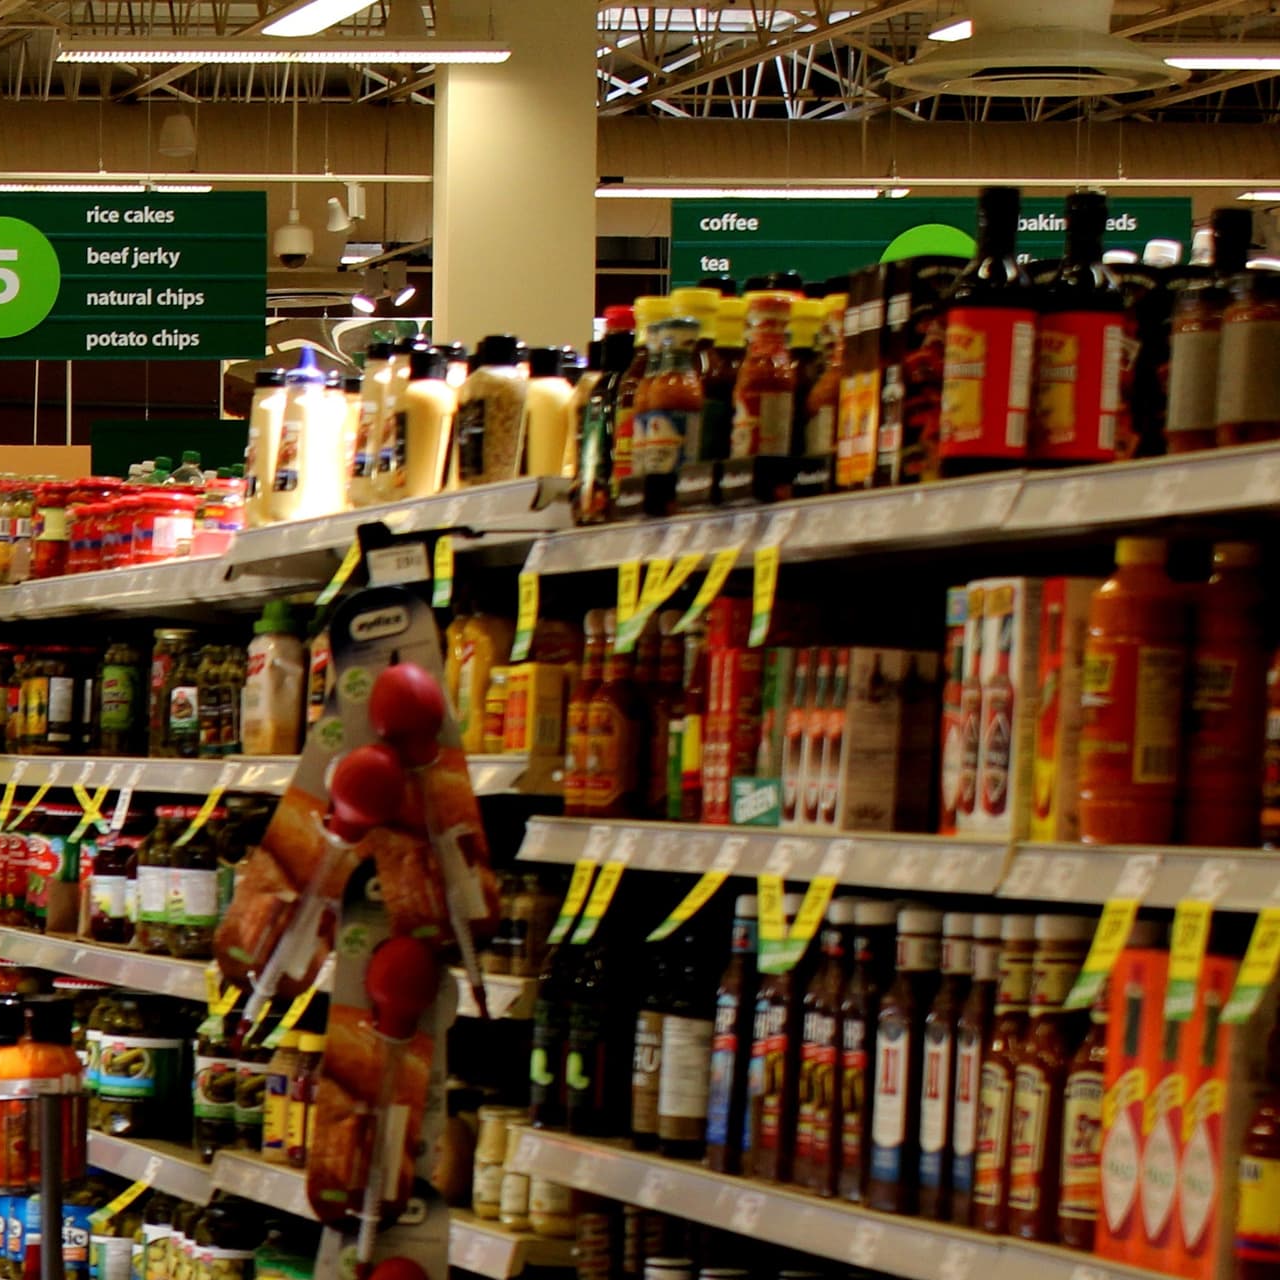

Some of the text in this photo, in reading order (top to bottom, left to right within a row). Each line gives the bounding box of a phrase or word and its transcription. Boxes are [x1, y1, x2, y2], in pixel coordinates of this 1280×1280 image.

[87, 206, 174, 223] rice cakes
[700, 213, 759, 230] coffee
[1017, 213, 1137, 231] bakin eds
[87, 246, 181, 268] beef jerky
[700, 256, 729, 271] tea
[87, 288, 204, 309] natural chips
[87, 329, 200, 350] potato chips
